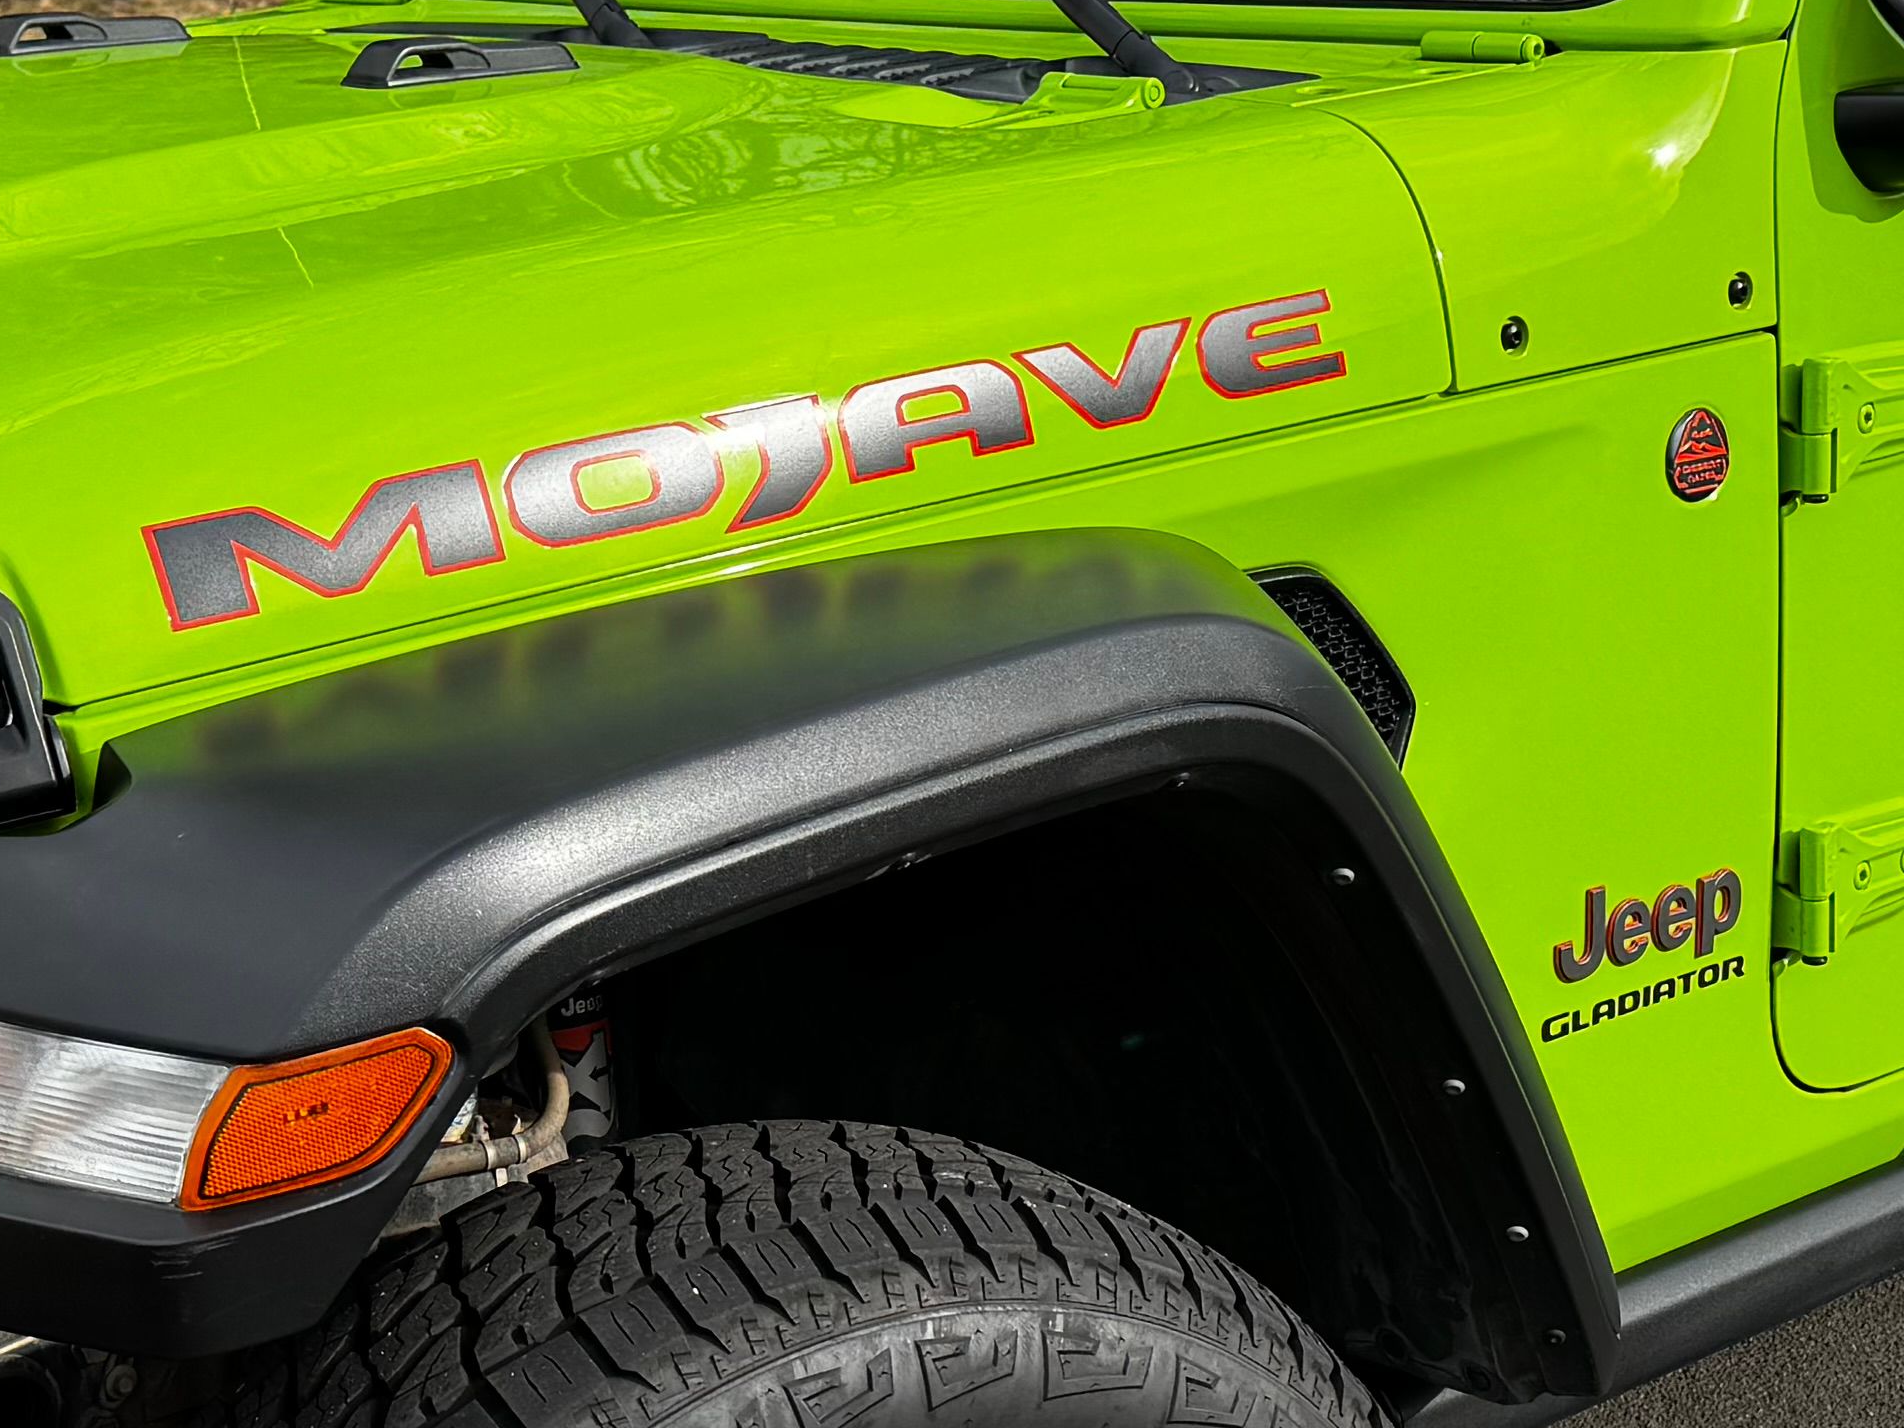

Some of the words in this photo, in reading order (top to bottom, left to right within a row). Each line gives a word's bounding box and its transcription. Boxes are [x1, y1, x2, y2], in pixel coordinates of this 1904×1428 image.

[142, 288, 1346, 632] MOJAVE
[1553, 868, 1742, 983] Jeep
[1541, 955, 1745, 1043] GLADIATOR
